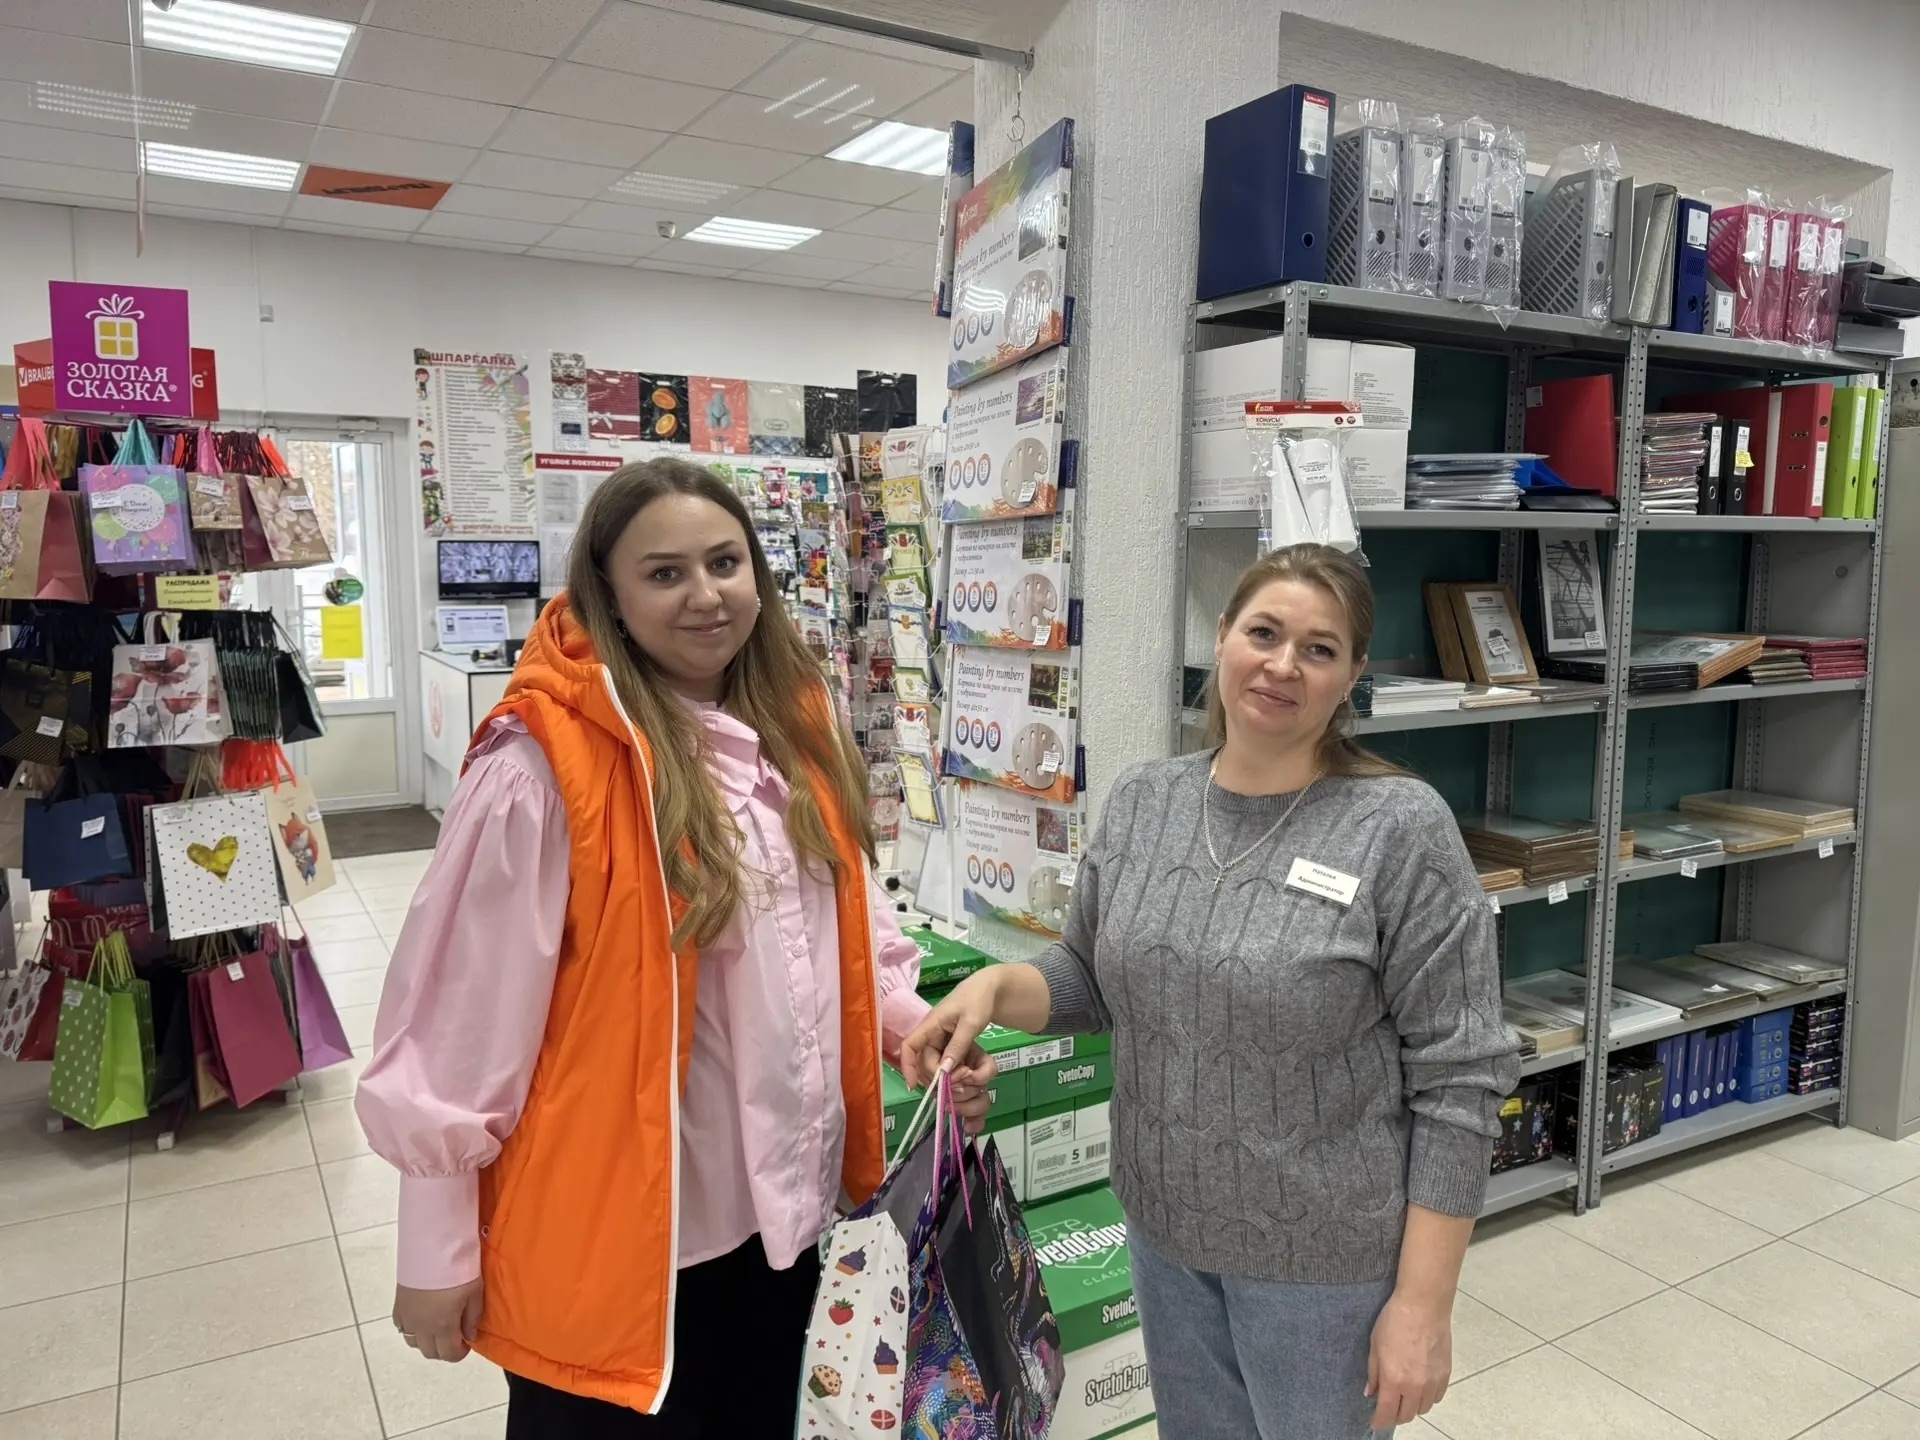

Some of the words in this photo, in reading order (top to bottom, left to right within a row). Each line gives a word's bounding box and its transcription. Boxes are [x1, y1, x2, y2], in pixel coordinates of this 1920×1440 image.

[430, 352, 516, 366] ШПАРГАЛКА
[67, 362, 168, 383] ЗОЛОТАЯ
[954, 402, 977, 418] Painting
[977, 397, 986, 415] by
[986, 390, 1014, 409] numbers
[540, 457, 570, 465] УГОЛОК
[571, 459, 621, 468] ПОКУПАТЕЛЯ
[981, 524, 990, 542] by
[990, 521, 1019, 537] numbers
[958, 662, 985, 681] Painting
[985, 664, 995, 682] by
[995, 666, 1025, 682] numbers
[964, 801, 990, 821] Painting
[991, 804, 1001, 822] by
[1001, 808, 1031, 825] numbers
[1312, 868, 1337, 880] Наталья
[1297, 875, 1345, 896] Администратор
[993, 1051, 1017, 1060] CLASSIC
[1057, 1064, 1096, 1085] SvetoCopy
[1071, 1148, 1080, 1160] 5
[1034, 1222, 1127, 1269] vetoCopy
[1085, 1363, 1151, 1407] SvetoCop
